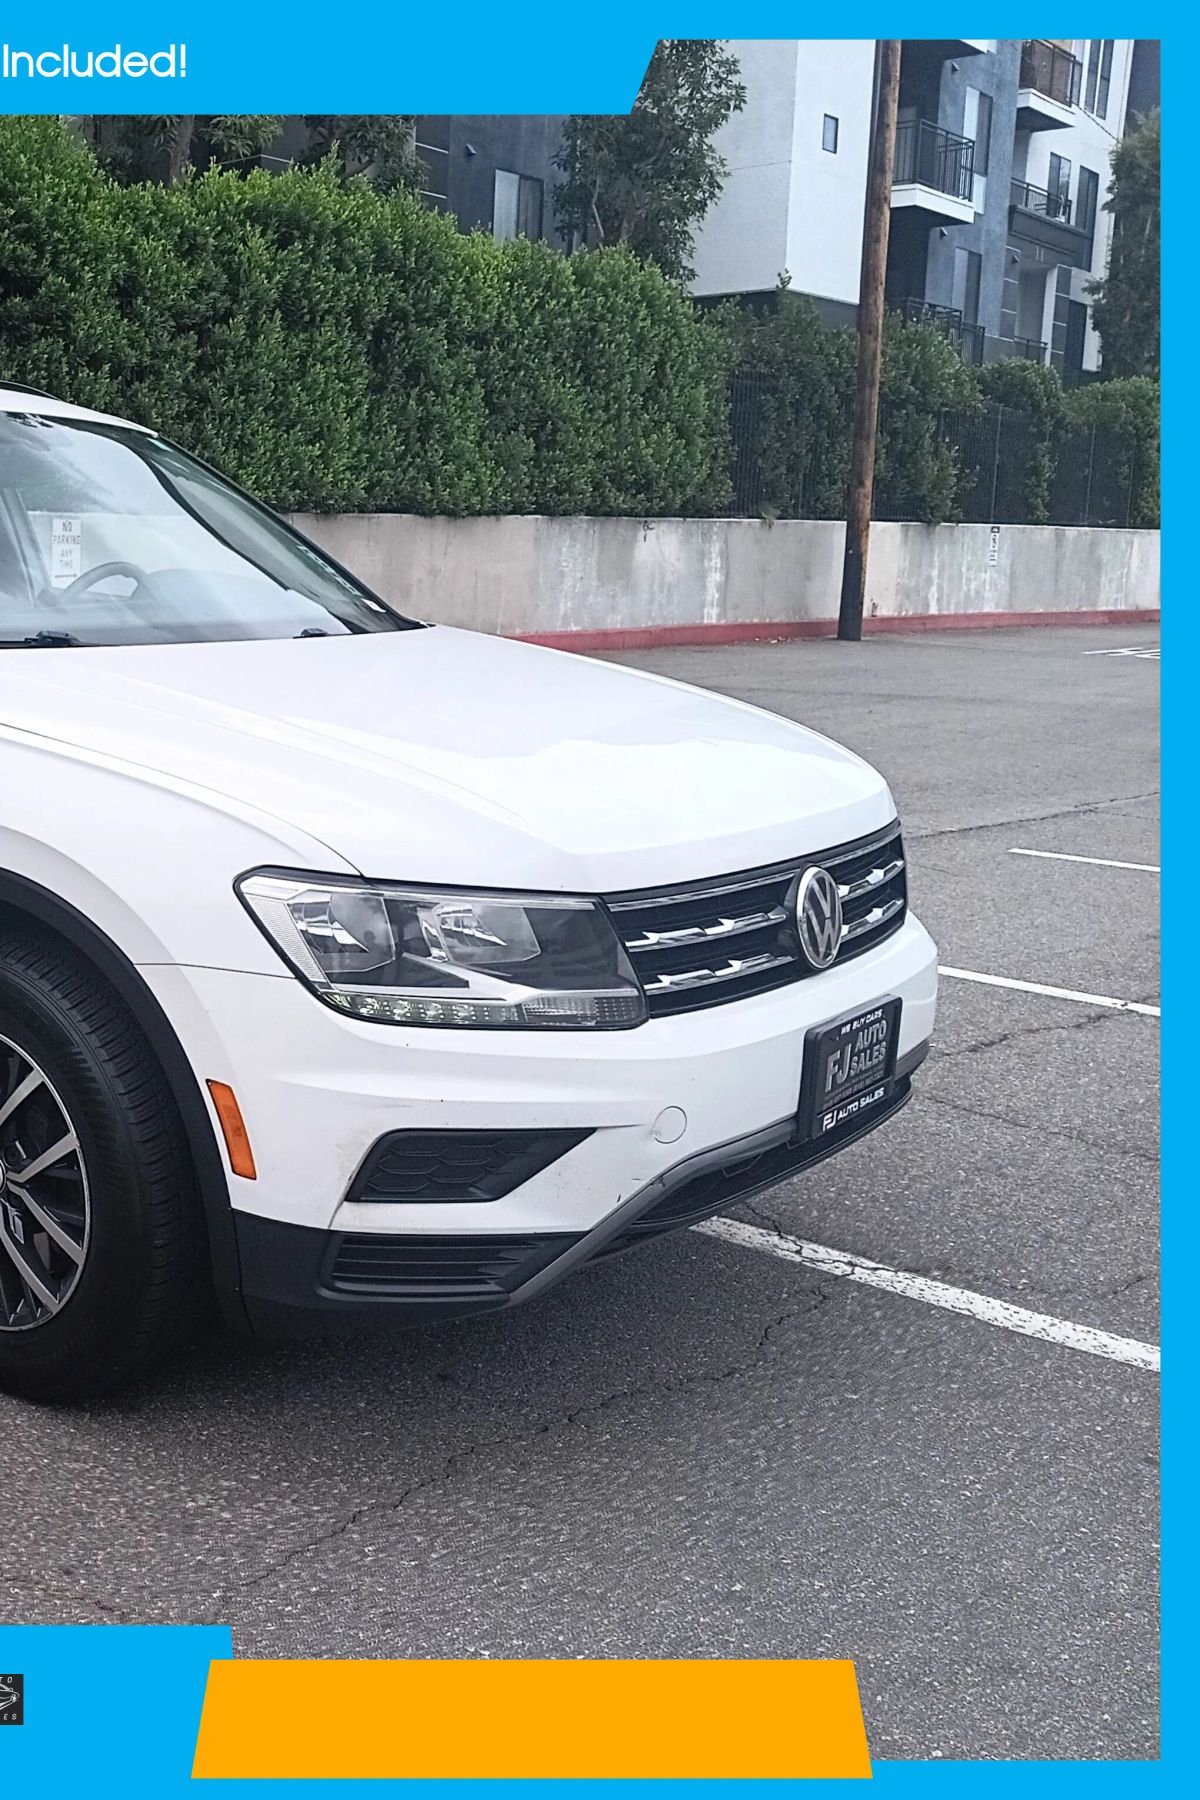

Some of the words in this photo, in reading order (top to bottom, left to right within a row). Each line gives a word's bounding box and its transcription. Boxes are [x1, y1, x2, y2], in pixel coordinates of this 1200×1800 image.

[53, 535, 80, 544] PARKING
[62, 521, 73, 533] NO
[852, 1016, 864, 1029] BUY
[865, 1009, 883, 1021] CARS
[855, 1020, 887, 1052] AUTO
[825, 1043, 852, 1093] FJ
[850, 1042, 887, 1076] SALES
[823, 1109, 837, 1131] FJ
[838, 1101, 858, 1120] AUTO
[860, 1088, 884, 1107] SALES
